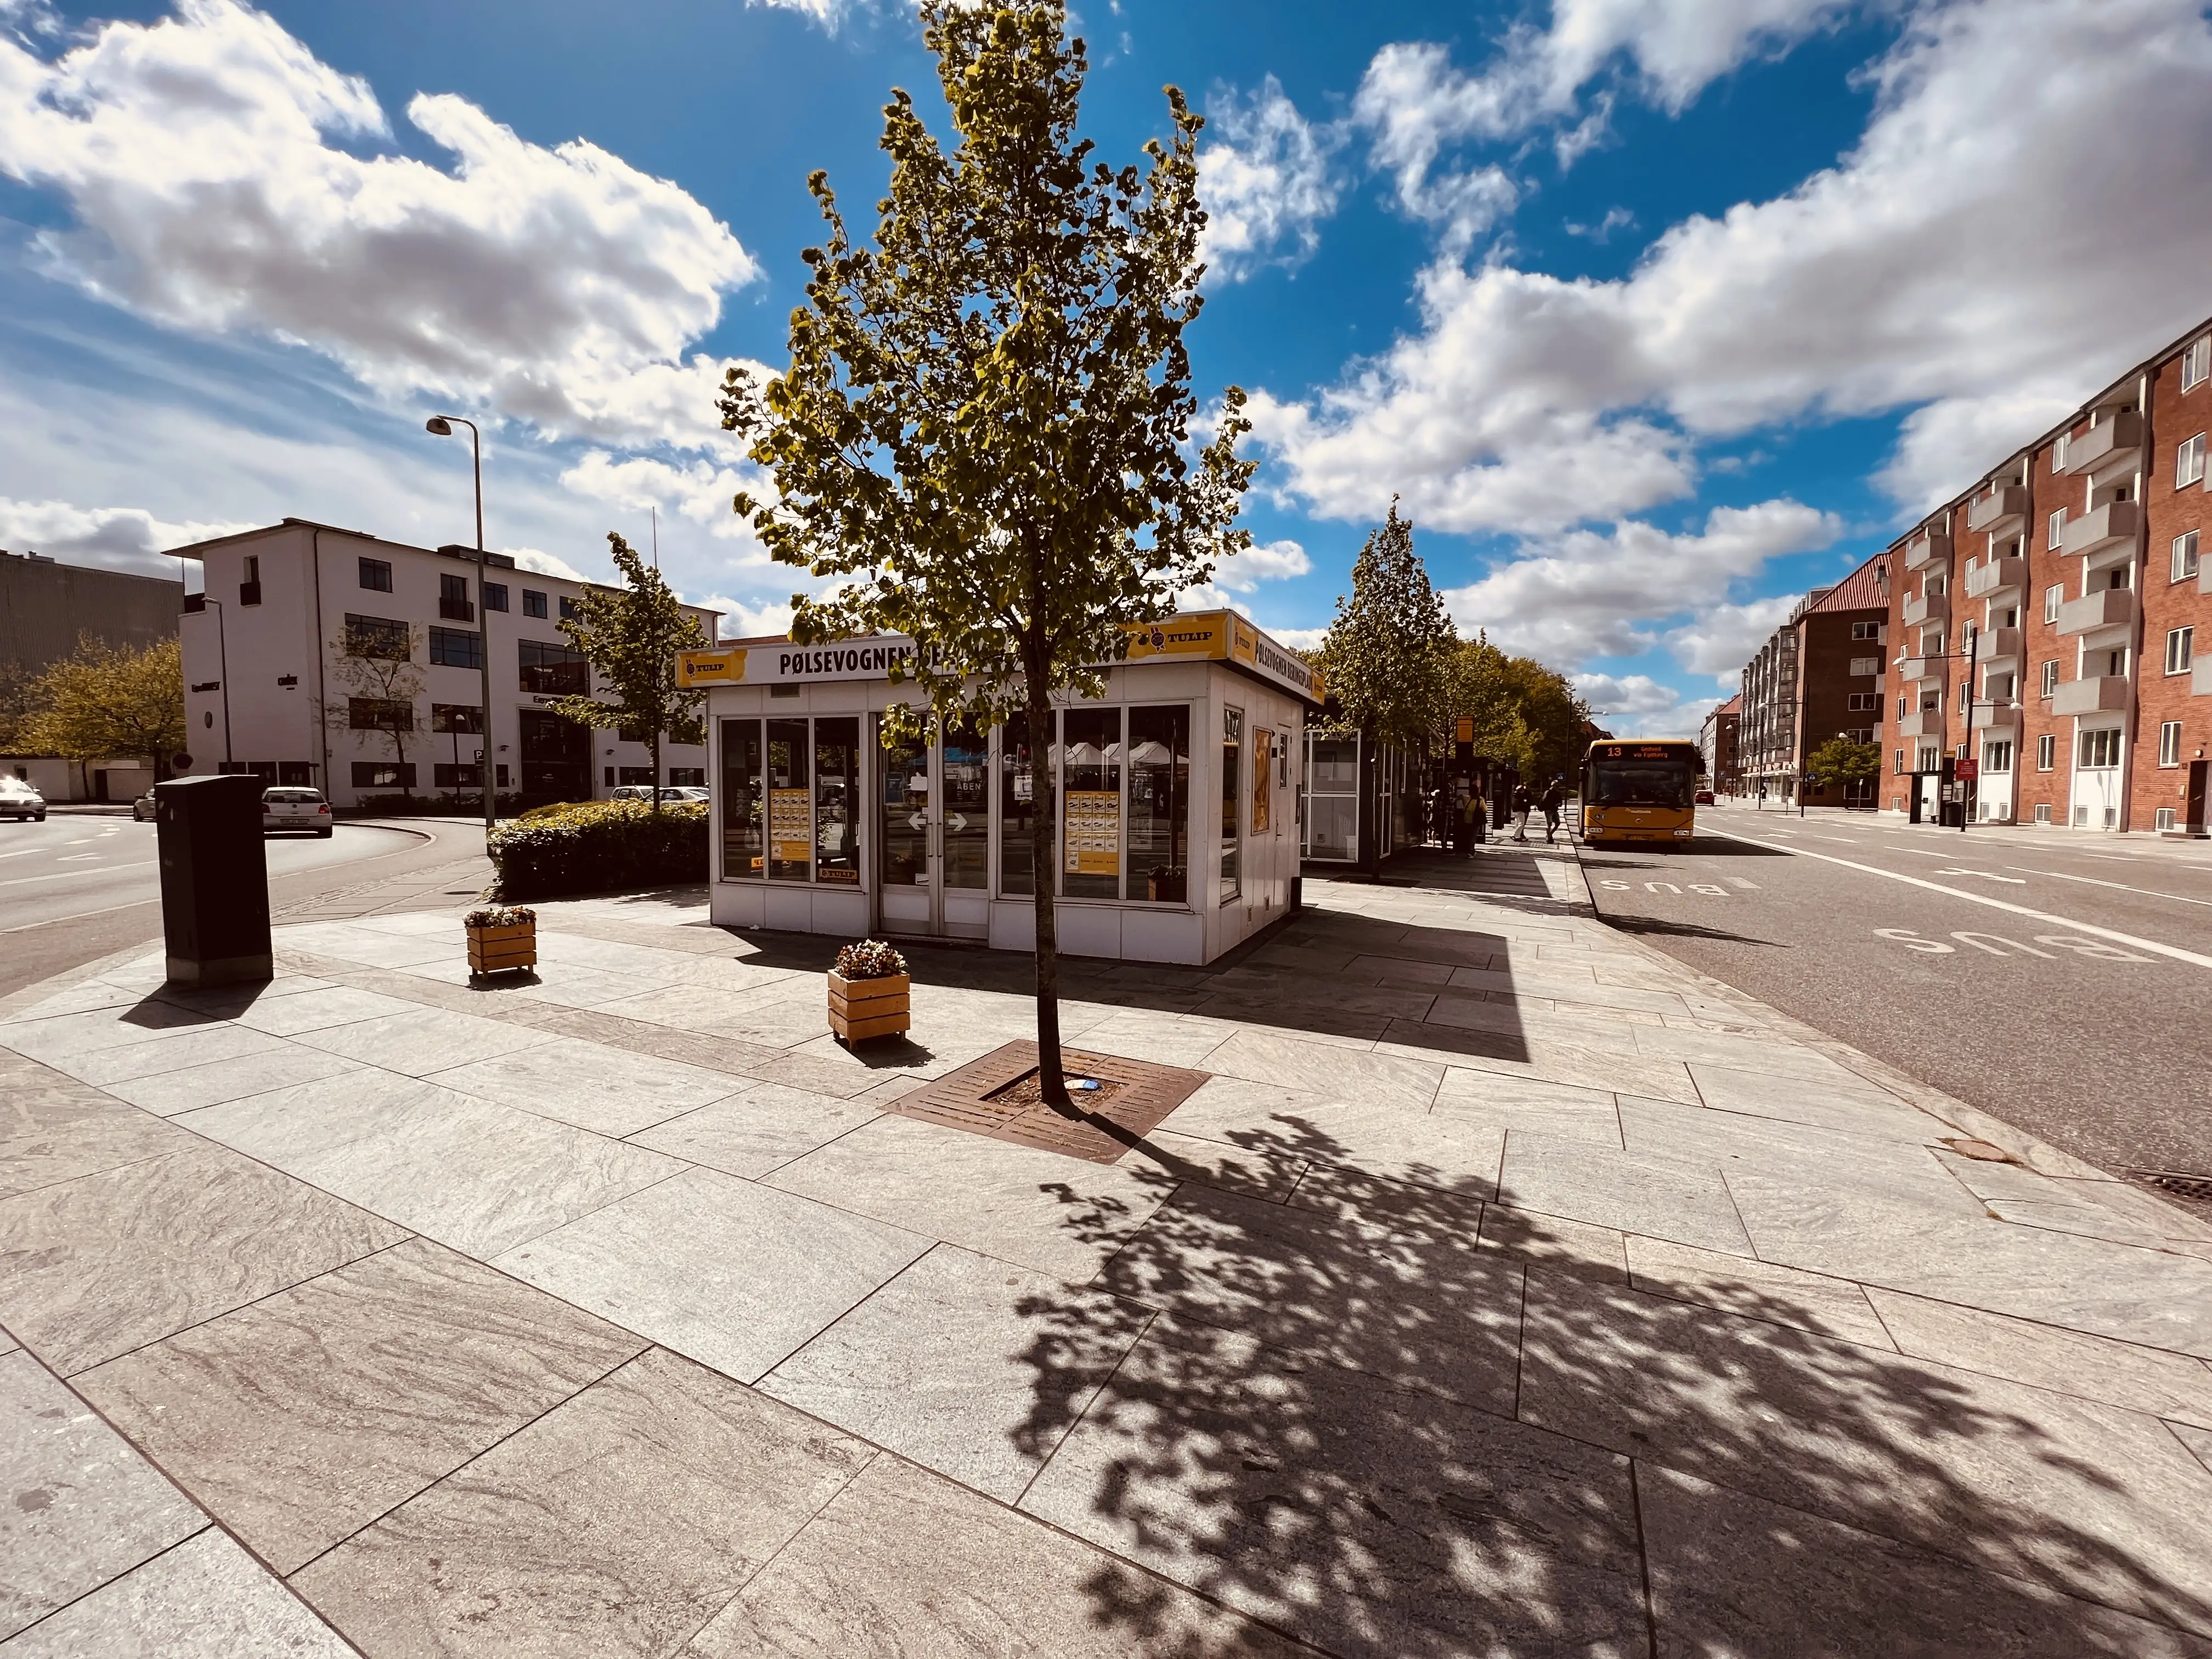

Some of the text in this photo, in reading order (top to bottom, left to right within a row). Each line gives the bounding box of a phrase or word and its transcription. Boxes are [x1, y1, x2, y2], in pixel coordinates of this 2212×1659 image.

[1167, 631, 1212, 642] TULIP
[780, 646, 911, 675] PØLSEVOGNEN
[1607, 747, 1622, 757] 13
[1600, 879, 1731, 896] BUS
[1872, 928, 2160, 964] BUS
